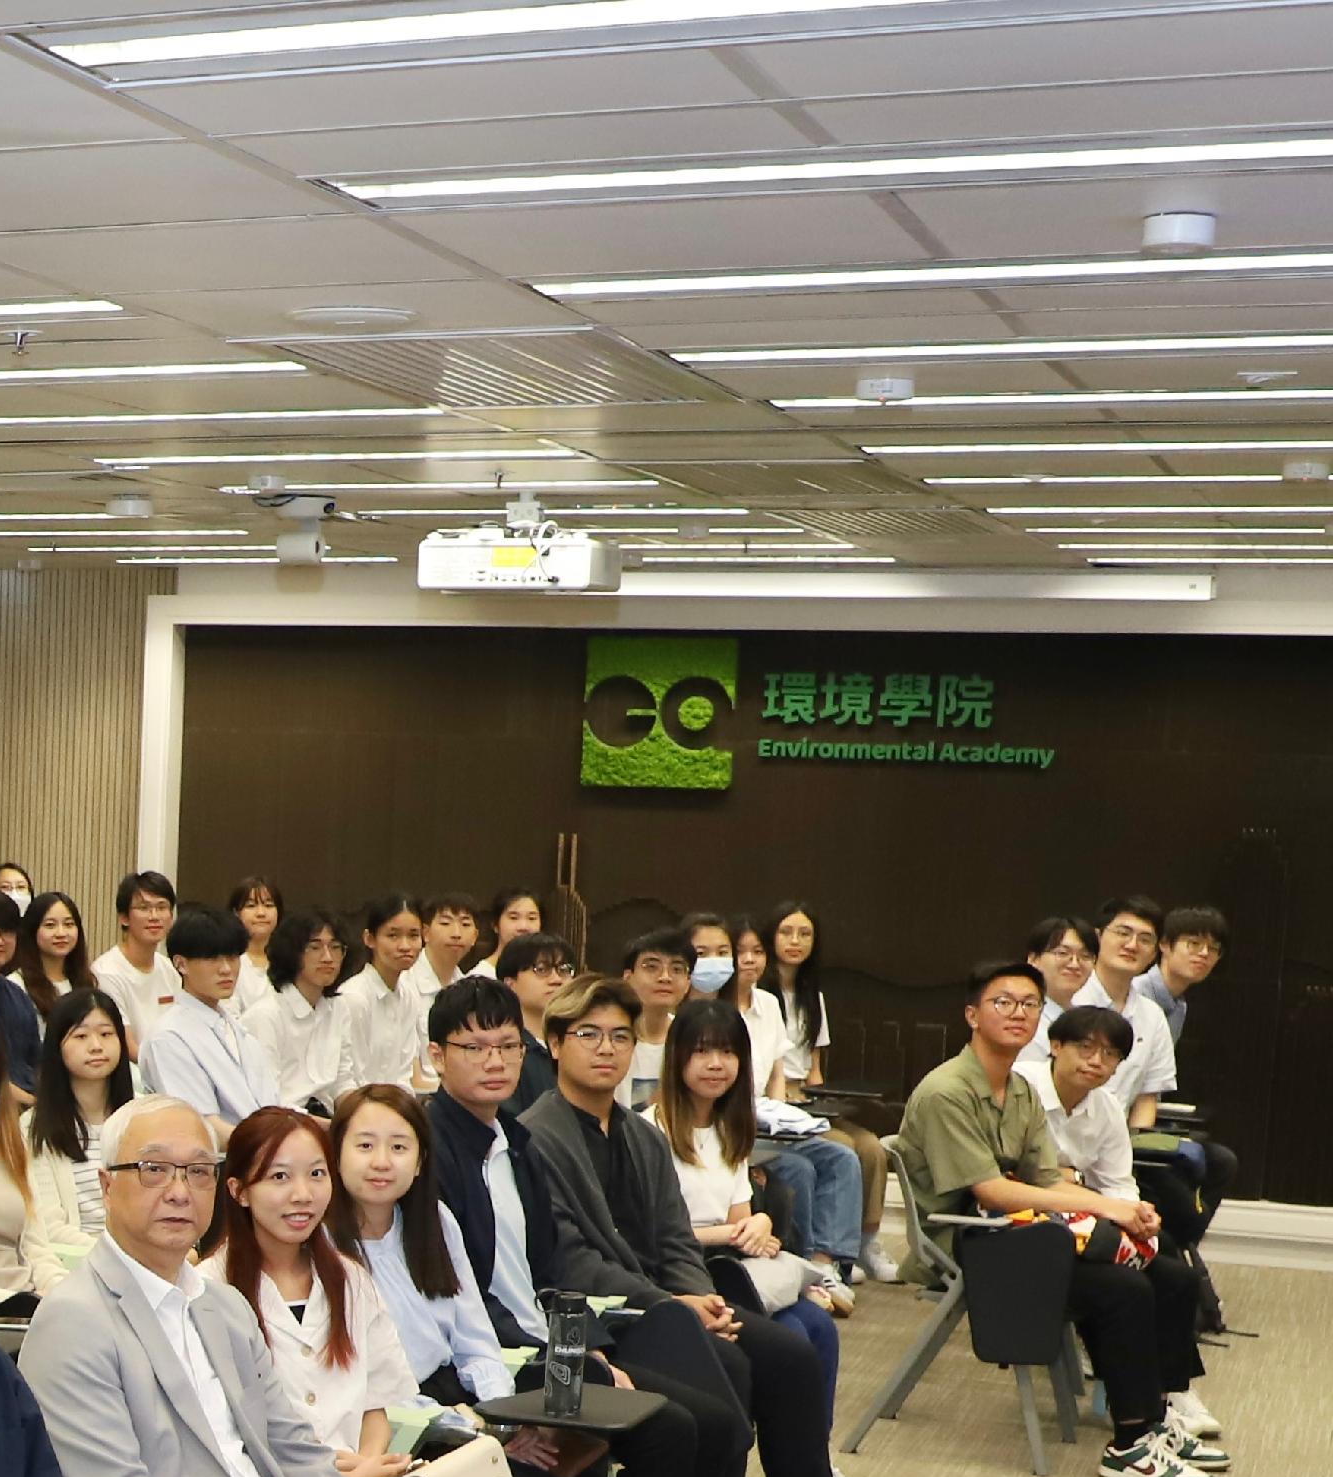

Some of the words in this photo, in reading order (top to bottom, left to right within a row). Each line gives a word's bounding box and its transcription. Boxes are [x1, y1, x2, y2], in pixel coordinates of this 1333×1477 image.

[761, 673, 994, 728] 環境學院
[757, 737, 934, 761] Environmental
[939, 742, 1055, 769] Academy
